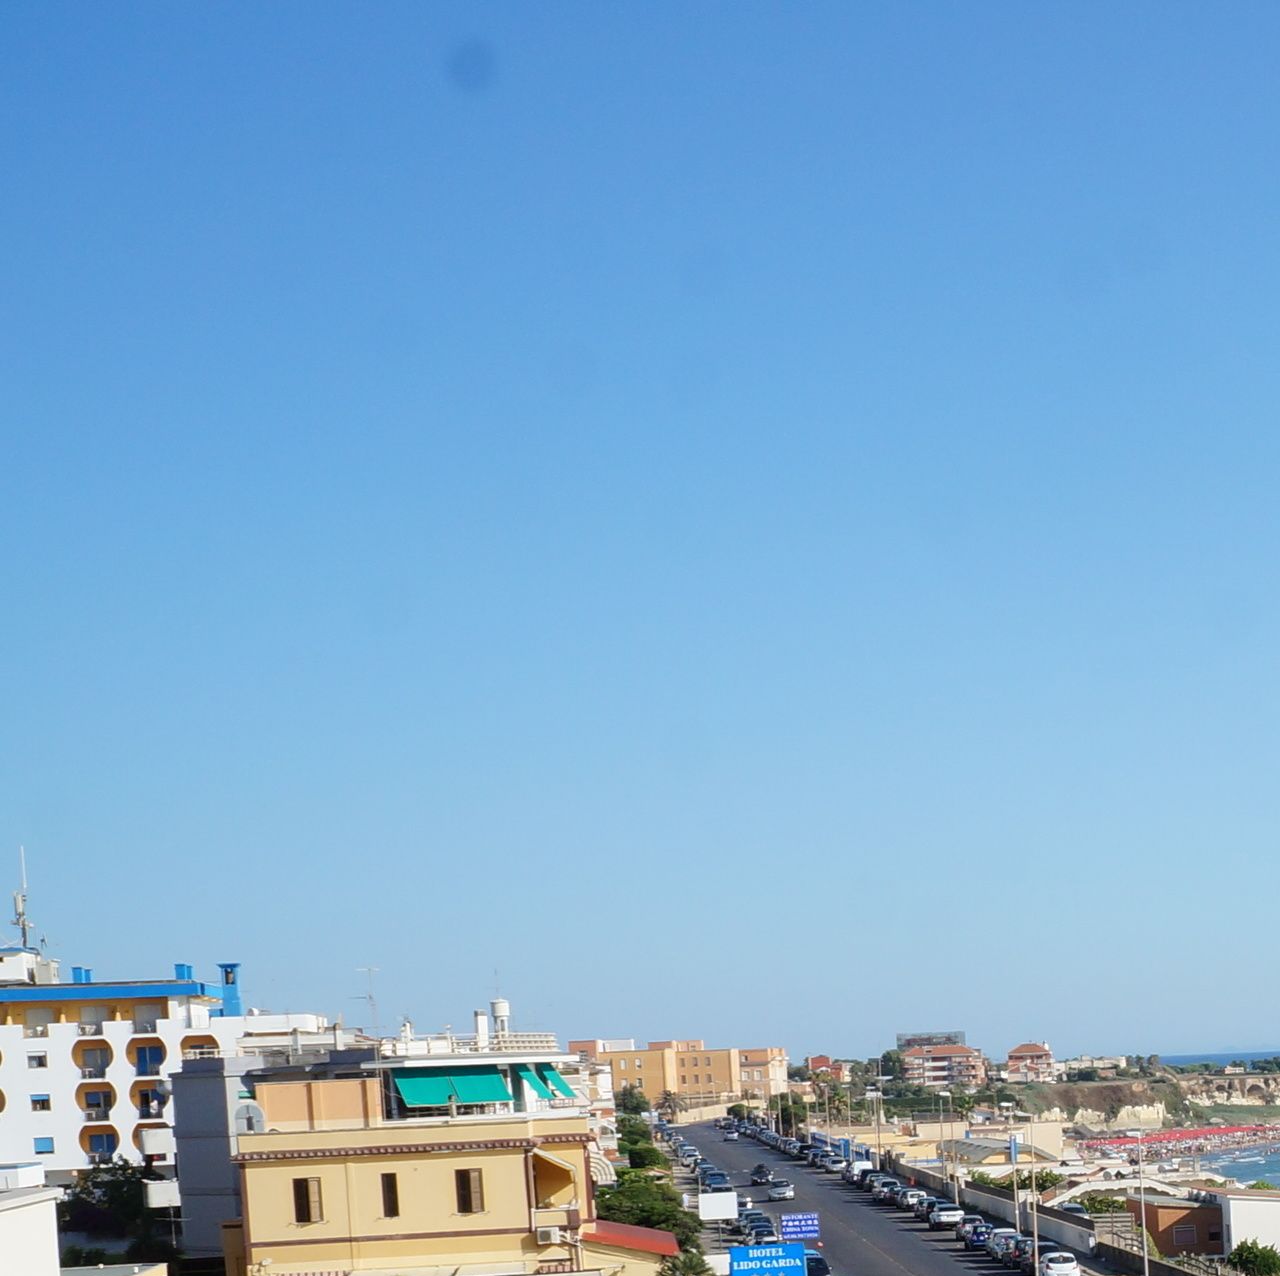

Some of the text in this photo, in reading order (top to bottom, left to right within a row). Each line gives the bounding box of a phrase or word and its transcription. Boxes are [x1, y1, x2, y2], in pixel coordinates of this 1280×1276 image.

[748, 1247, 786, 1258] HOTEL
[733, 1258, 802, 1270] LIDO GARDA
